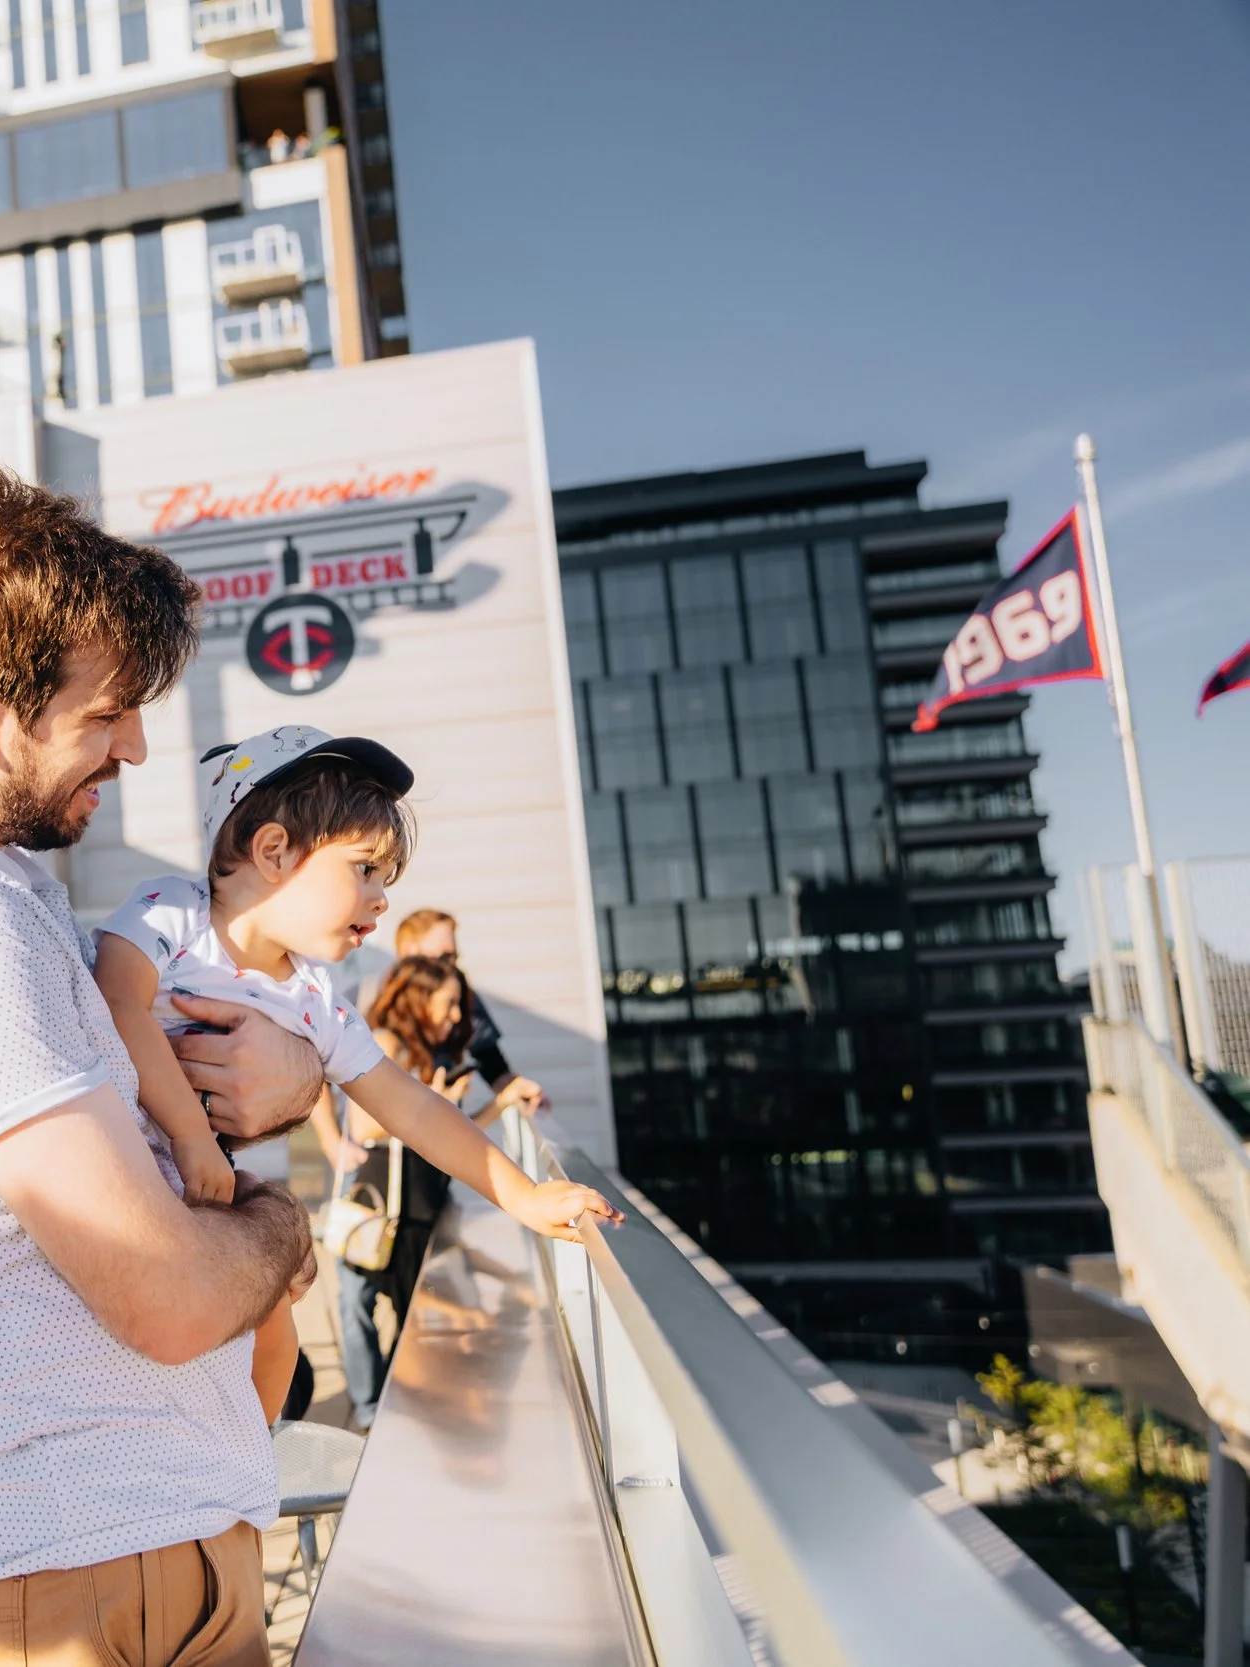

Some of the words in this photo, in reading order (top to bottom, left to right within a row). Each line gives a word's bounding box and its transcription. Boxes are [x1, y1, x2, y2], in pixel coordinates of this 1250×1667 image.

[140, 464, 436, 534] Budweiser
[200, 570, 274, 603] OOF
[310, 553, 409, 591] DECK
[943, 569, 1082, 695] 1969
